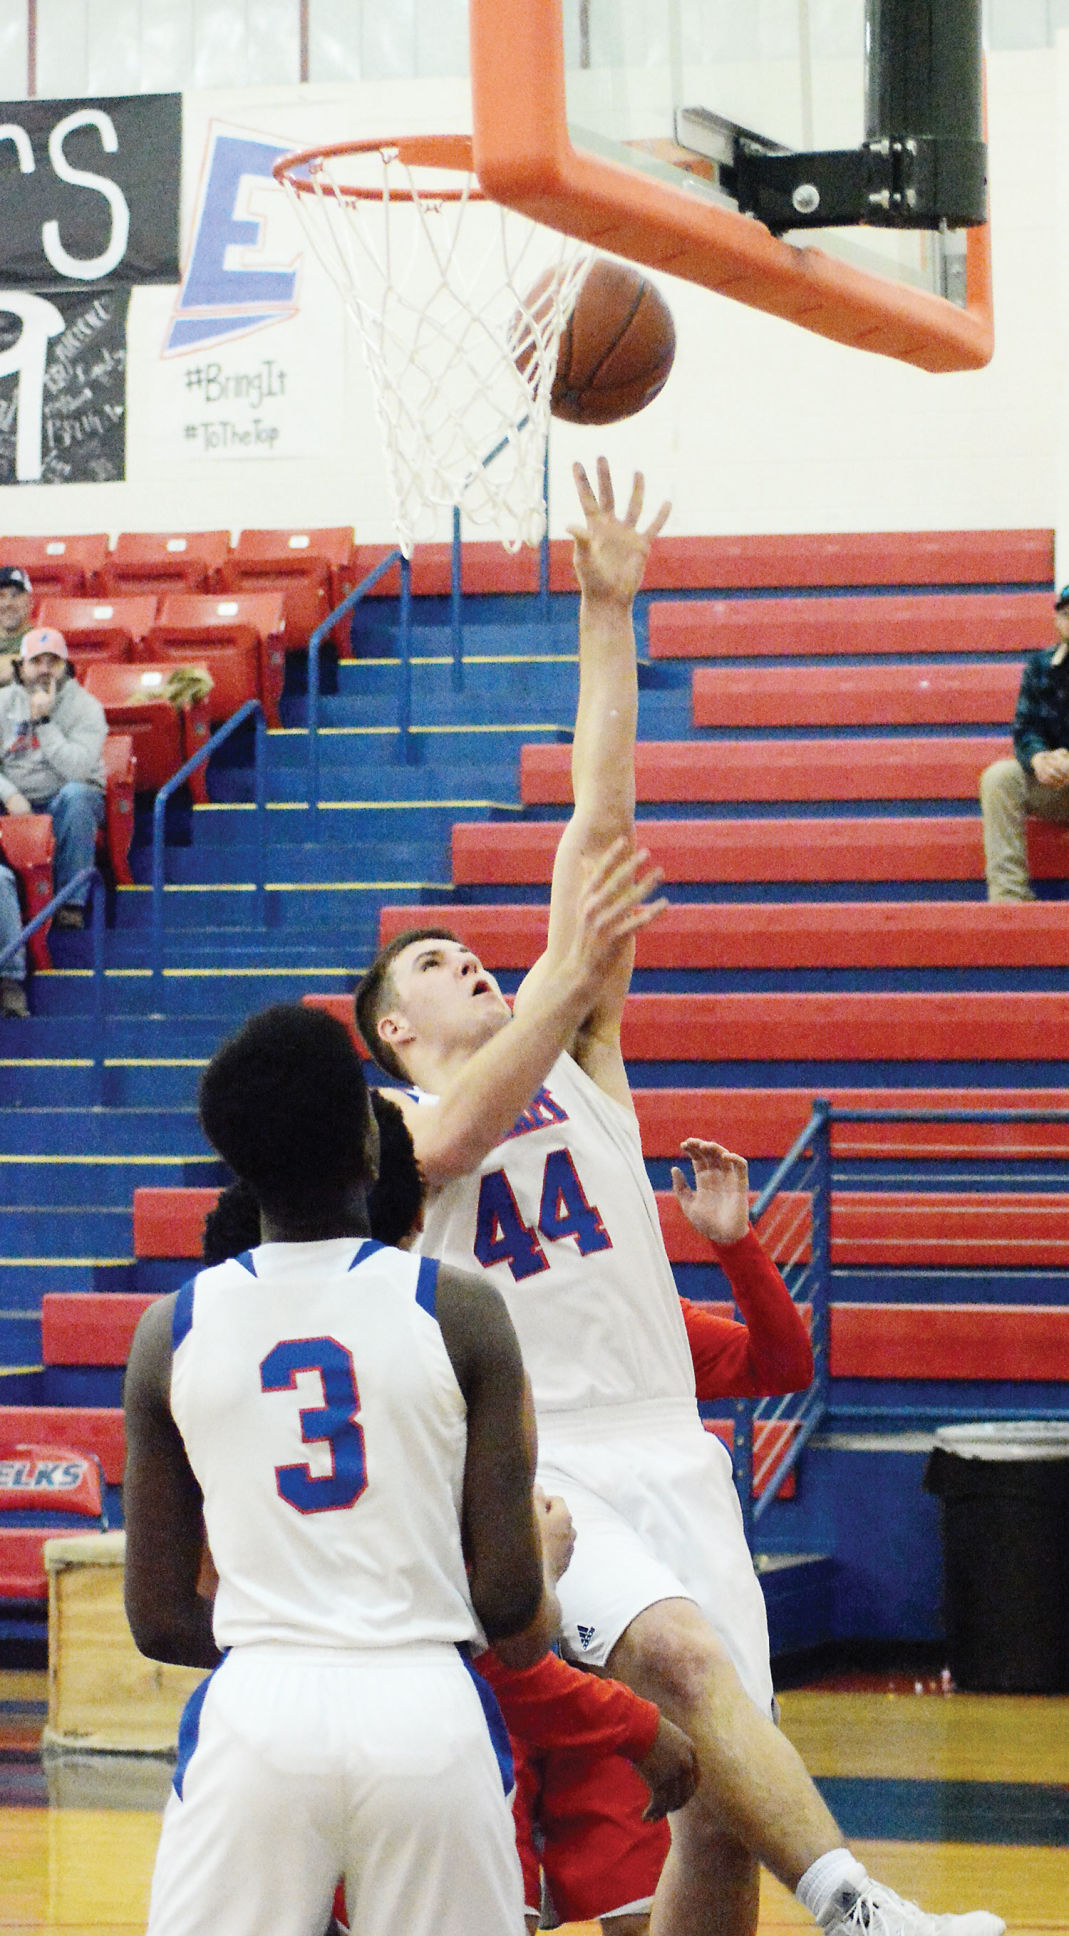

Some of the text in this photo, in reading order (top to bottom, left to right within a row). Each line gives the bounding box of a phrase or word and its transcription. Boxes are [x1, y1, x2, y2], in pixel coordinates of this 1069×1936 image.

[176, 118, 318, 310] E
[185, 359, 287, 410] #BringIt
[184, 418, 279, 452] #ToTheTop
[473, 1147, 614, 1283] 44
[258, 1335, 369, 1515] 3
[0, 1462, 82, 1487] ELKS
